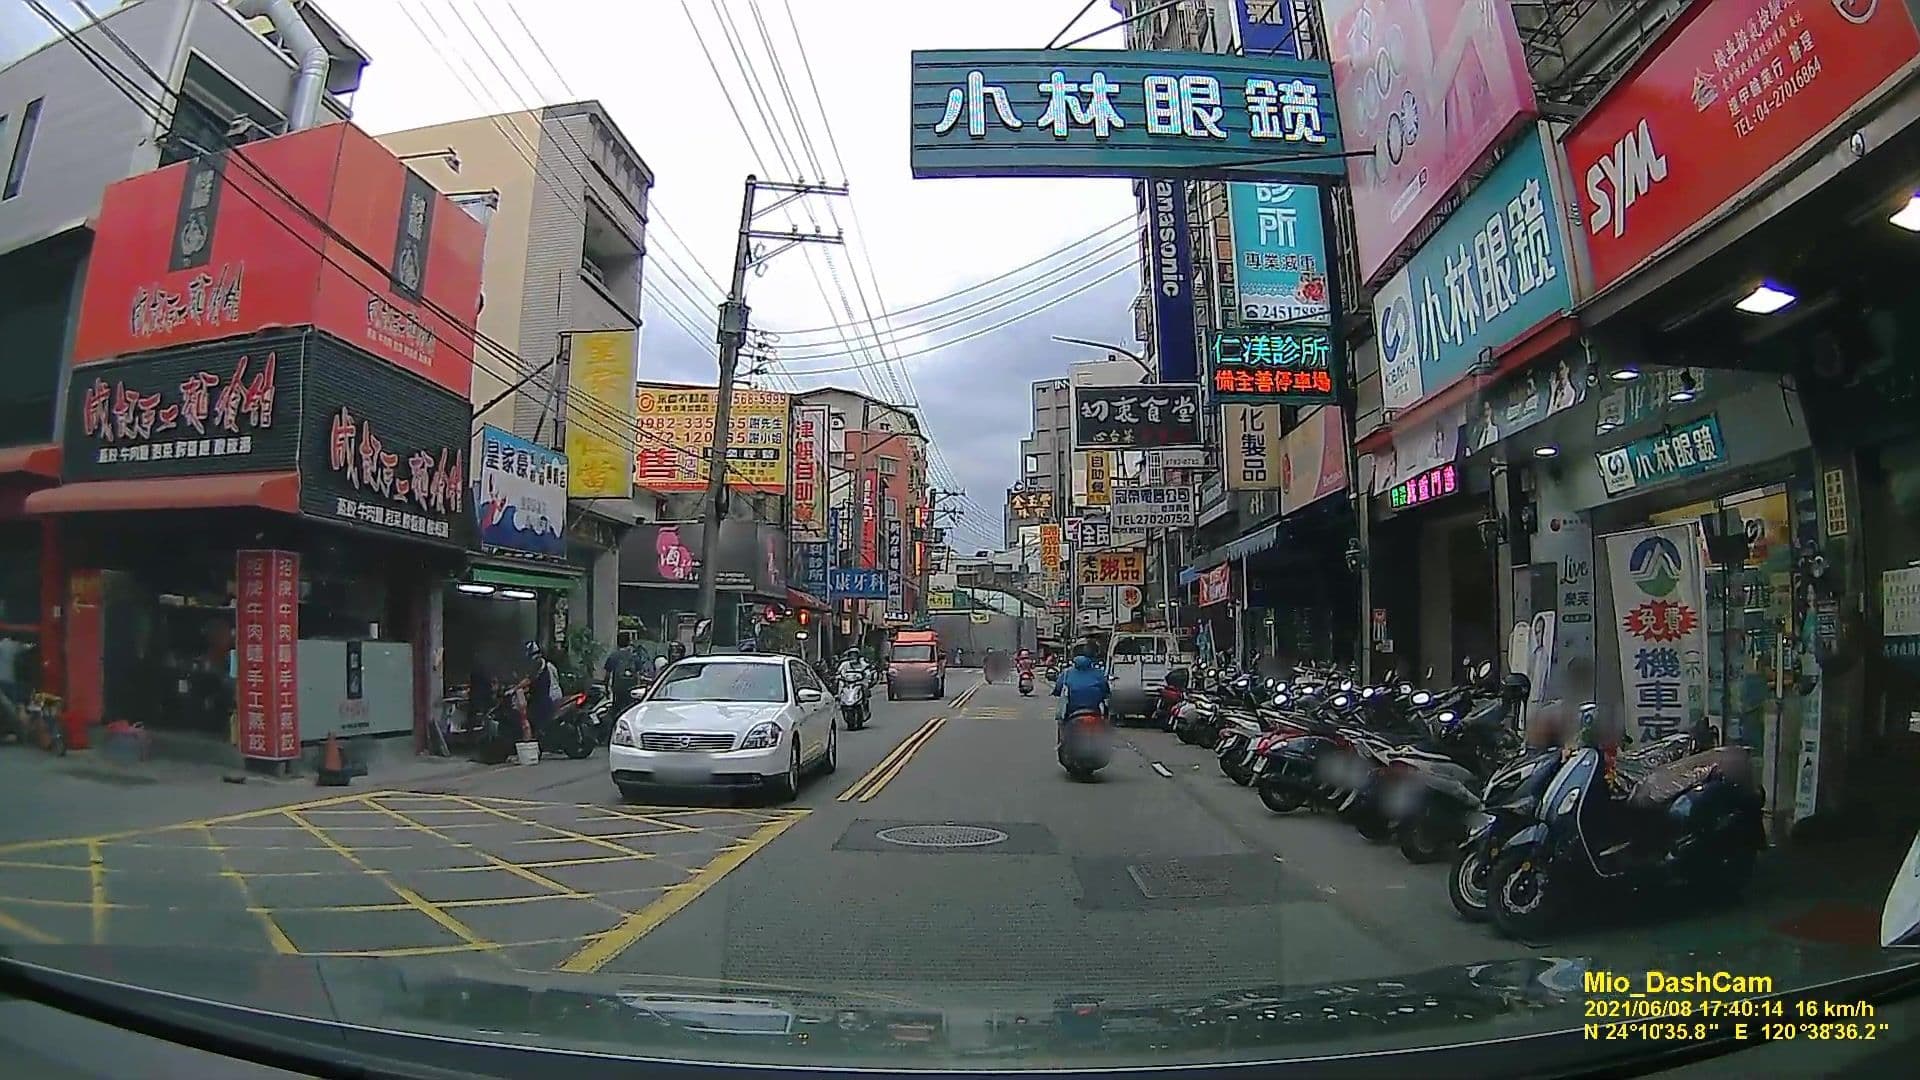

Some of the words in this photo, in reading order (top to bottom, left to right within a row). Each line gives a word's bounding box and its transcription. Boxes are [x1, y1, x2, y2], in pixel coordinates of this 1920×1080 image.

[933, 70, 1324, 142] 小林眼鏡
[1584, 118, 1677, 239] SYM
[1155, 180, 1184, 297] anasonic
[1420, 176, 1558, 362] 小林眼鏡
[637, 447, 681, 480] 售
[1239, 407, 1267, 484] 化製品
[1636, 425, 1718, 479] 小林眼鏡
[1083, 524, 1110, 545] 全民
[1638, 607, 1684, 637] 免費
